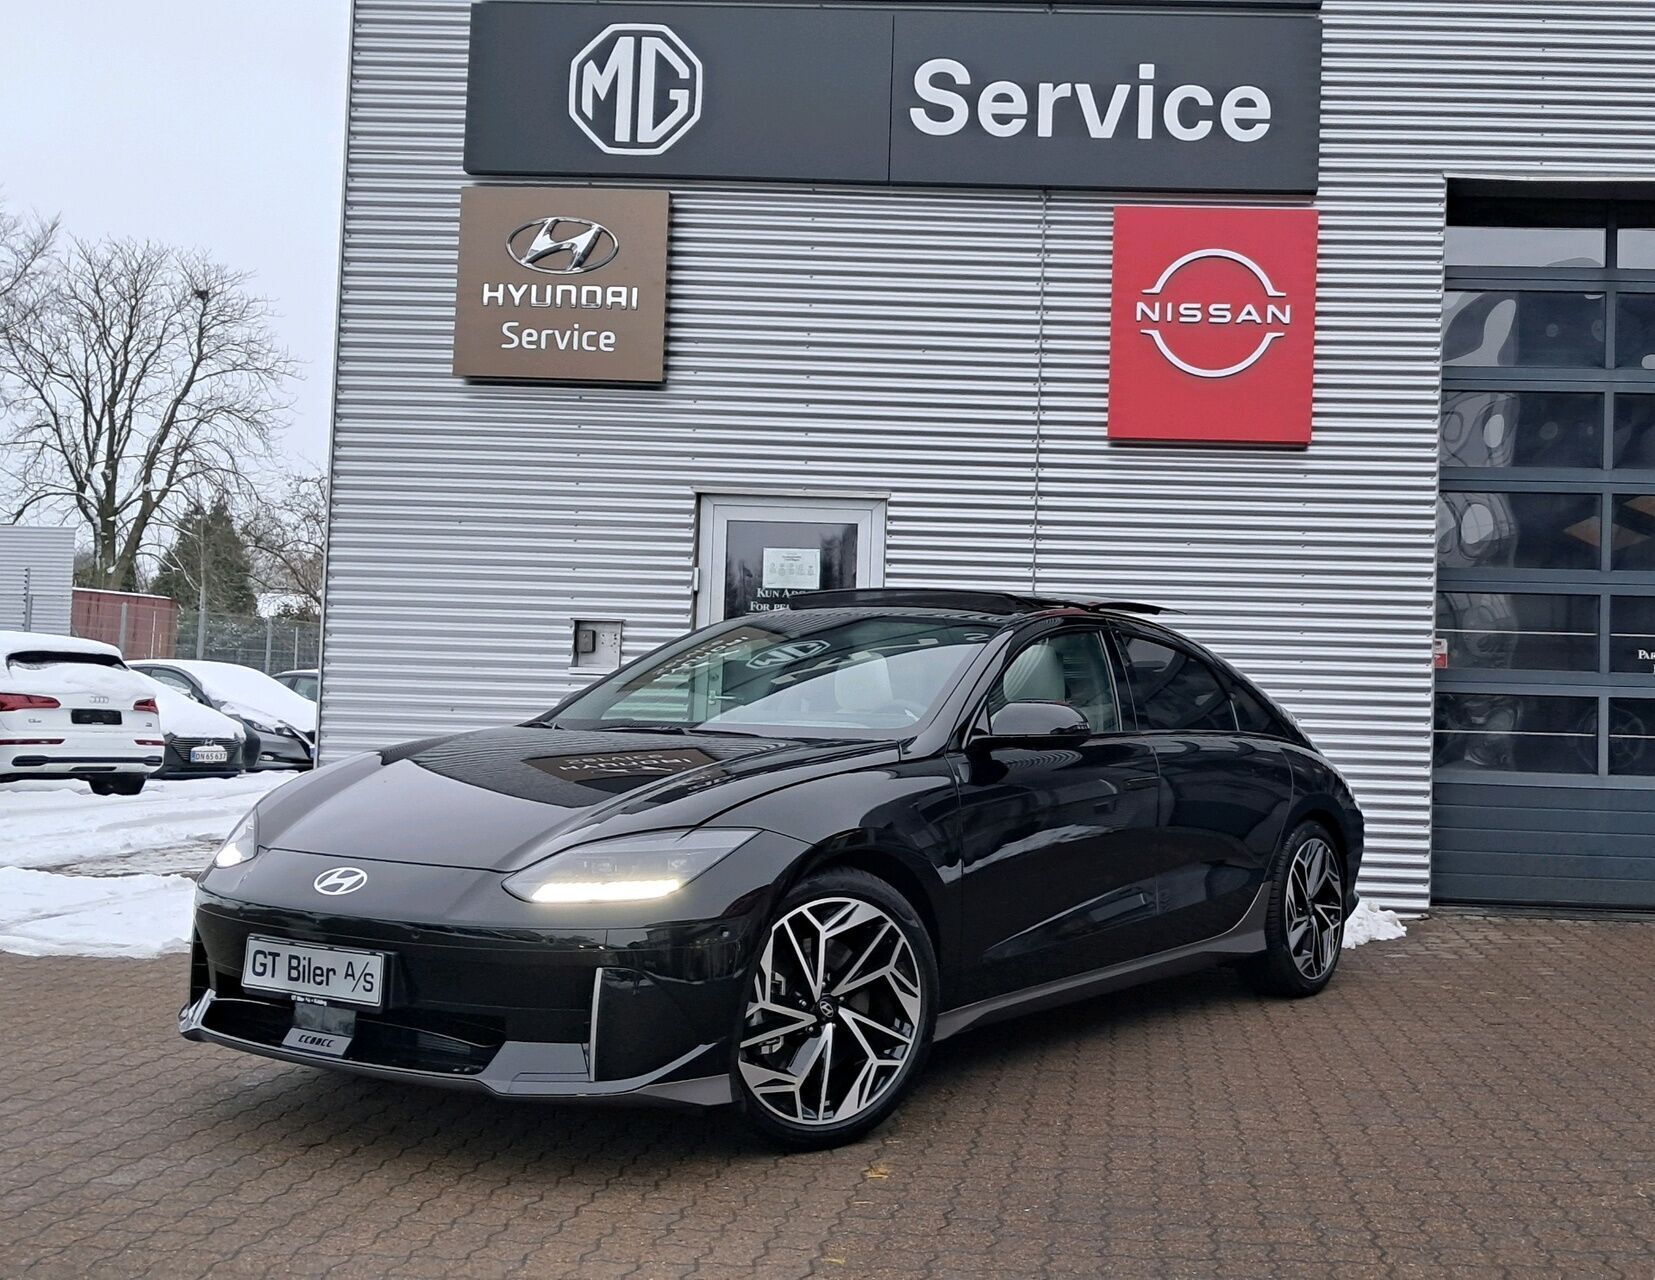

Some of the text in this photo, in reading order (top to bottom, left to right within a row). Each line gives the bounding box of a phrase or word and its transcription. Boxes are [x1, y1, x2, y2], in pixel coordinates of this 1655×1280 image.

[581, 36, 690, 143] MG
[909, 58, 1272, 143] Service
[482, 282, 639, 311] HYUNDAI
[1136, 301, 1292, 326] NISSAN
[501, 321, 616, 352] Service
[252, 949, 374, 993] GT Biler A/S
